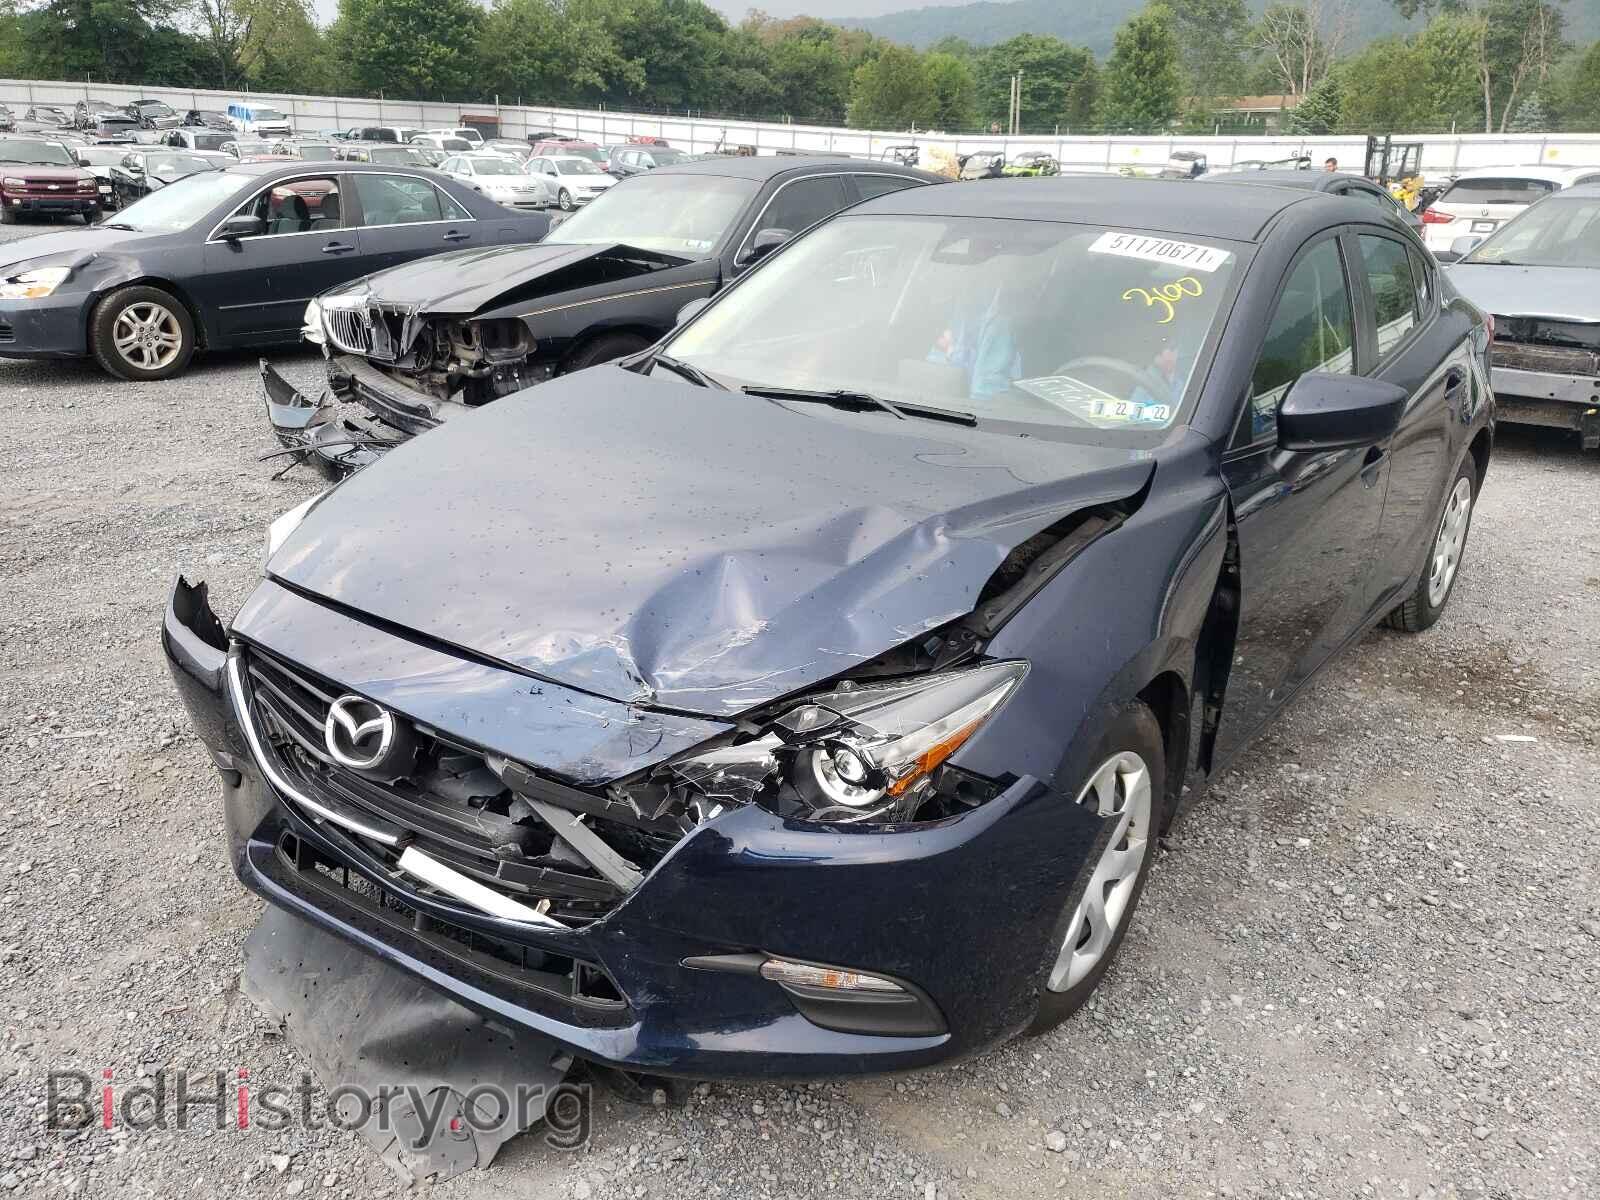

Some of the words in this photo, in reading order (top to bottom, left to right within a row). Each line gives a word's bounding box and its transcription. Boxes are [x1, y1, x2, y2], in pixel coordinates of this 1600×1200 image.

[1110, 235, 1209, 263] 51170671
[1115, 402, 1127, 416] 22
[1153, 405, 1165, 420] 22
